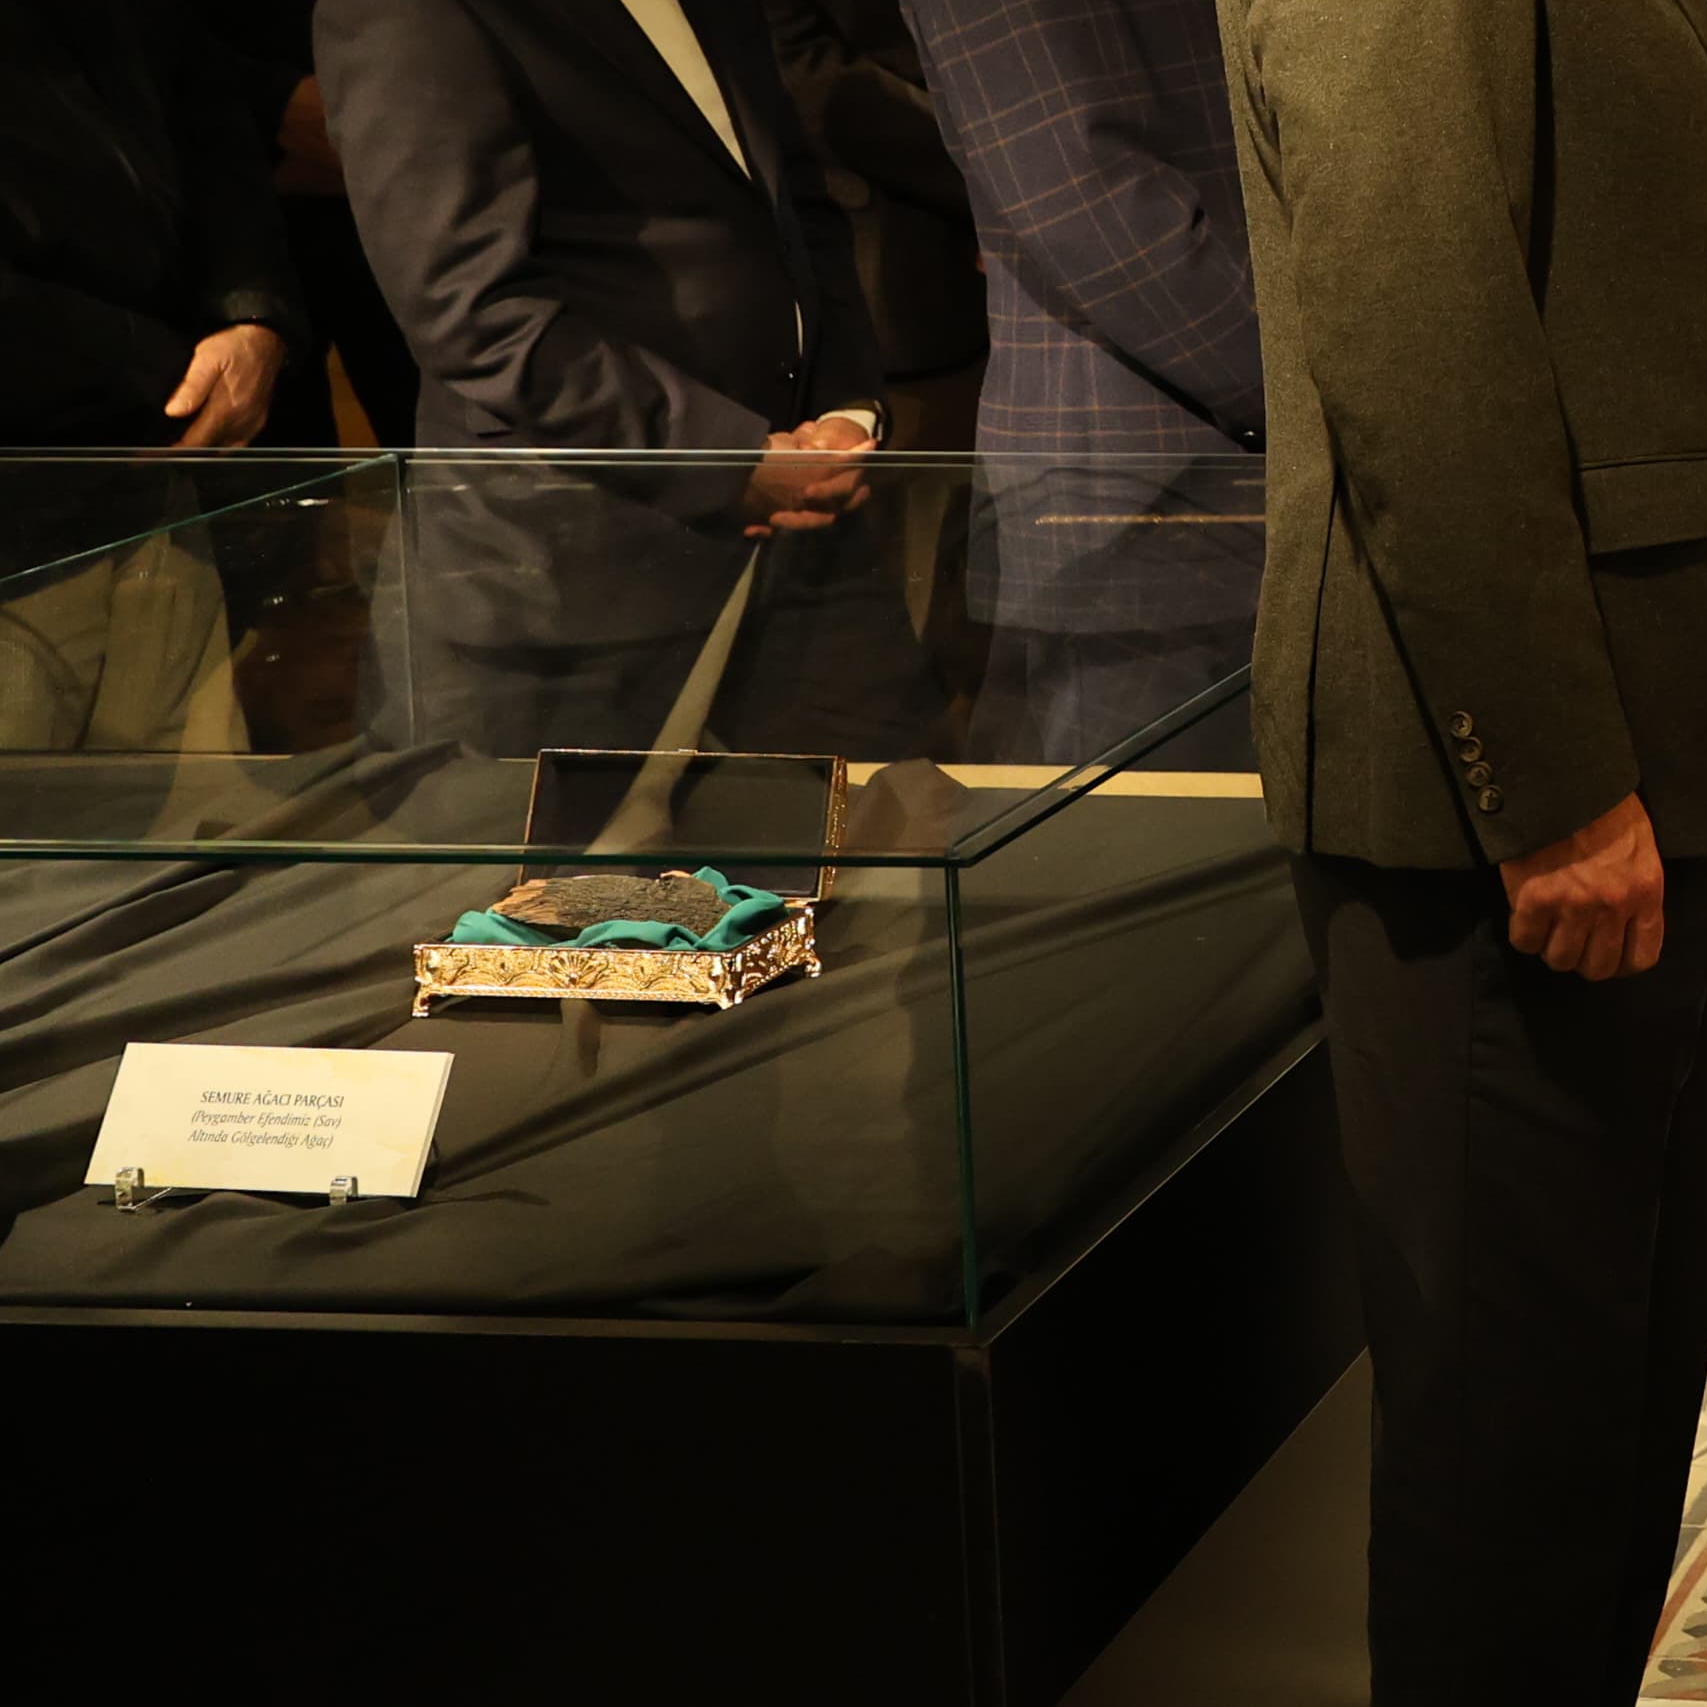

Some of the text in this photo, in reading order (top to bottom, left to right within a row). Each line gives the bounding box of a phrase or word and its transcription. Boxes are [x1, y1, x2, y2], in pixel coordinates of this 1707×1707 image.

[200, 1090, 345, 1110] SEMURE AĞACI PARÇASI
[191, 1109, 342, 1129] (Peygamber Efendimiz (Sav)
[187, 1128, 228, 1143] Altında
[301, 1133, 334, 1149] Ağaç)
